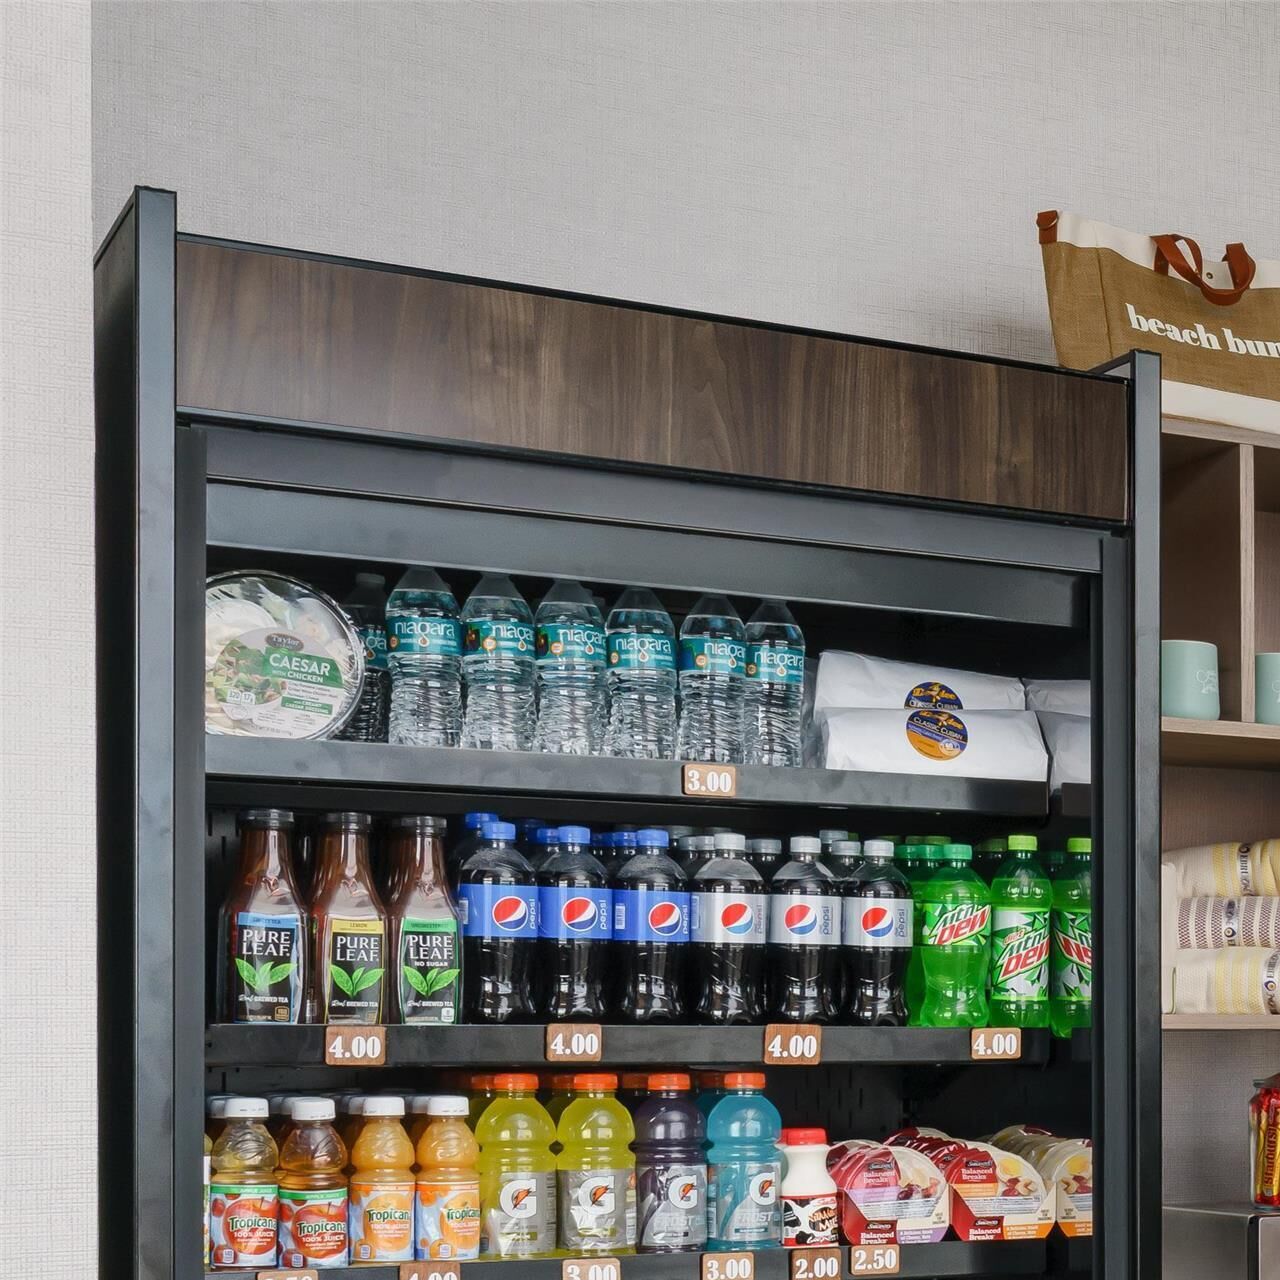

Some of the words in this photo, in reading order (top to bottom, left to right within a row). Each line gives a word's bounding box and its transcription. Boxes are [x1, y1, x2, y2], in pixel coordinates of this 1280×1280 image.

[1124, 302, 1223, 350] beach
[394, 621, 456, 640] niagara
[269, 653, 331, 677] CAESAR
[688, 770, 732, 794] 3.00
[242, 929, 291, 944] PURE
[336, 936, 379, 950] PURE
[328, 1035, 382, 1058] 4.00
[550, 1032, 599, 1056] 4.00
[767, 1034, 817, 1058] 4.00
[971, 1034, 1019, 1056] 4.00
[500, 1178, 537, 1219] G
[228, 1216, 277, 1231] Tropicana
[795, 1256, 839, 1279] 2.00
[854, 1248, 897, 1271] 2.50
